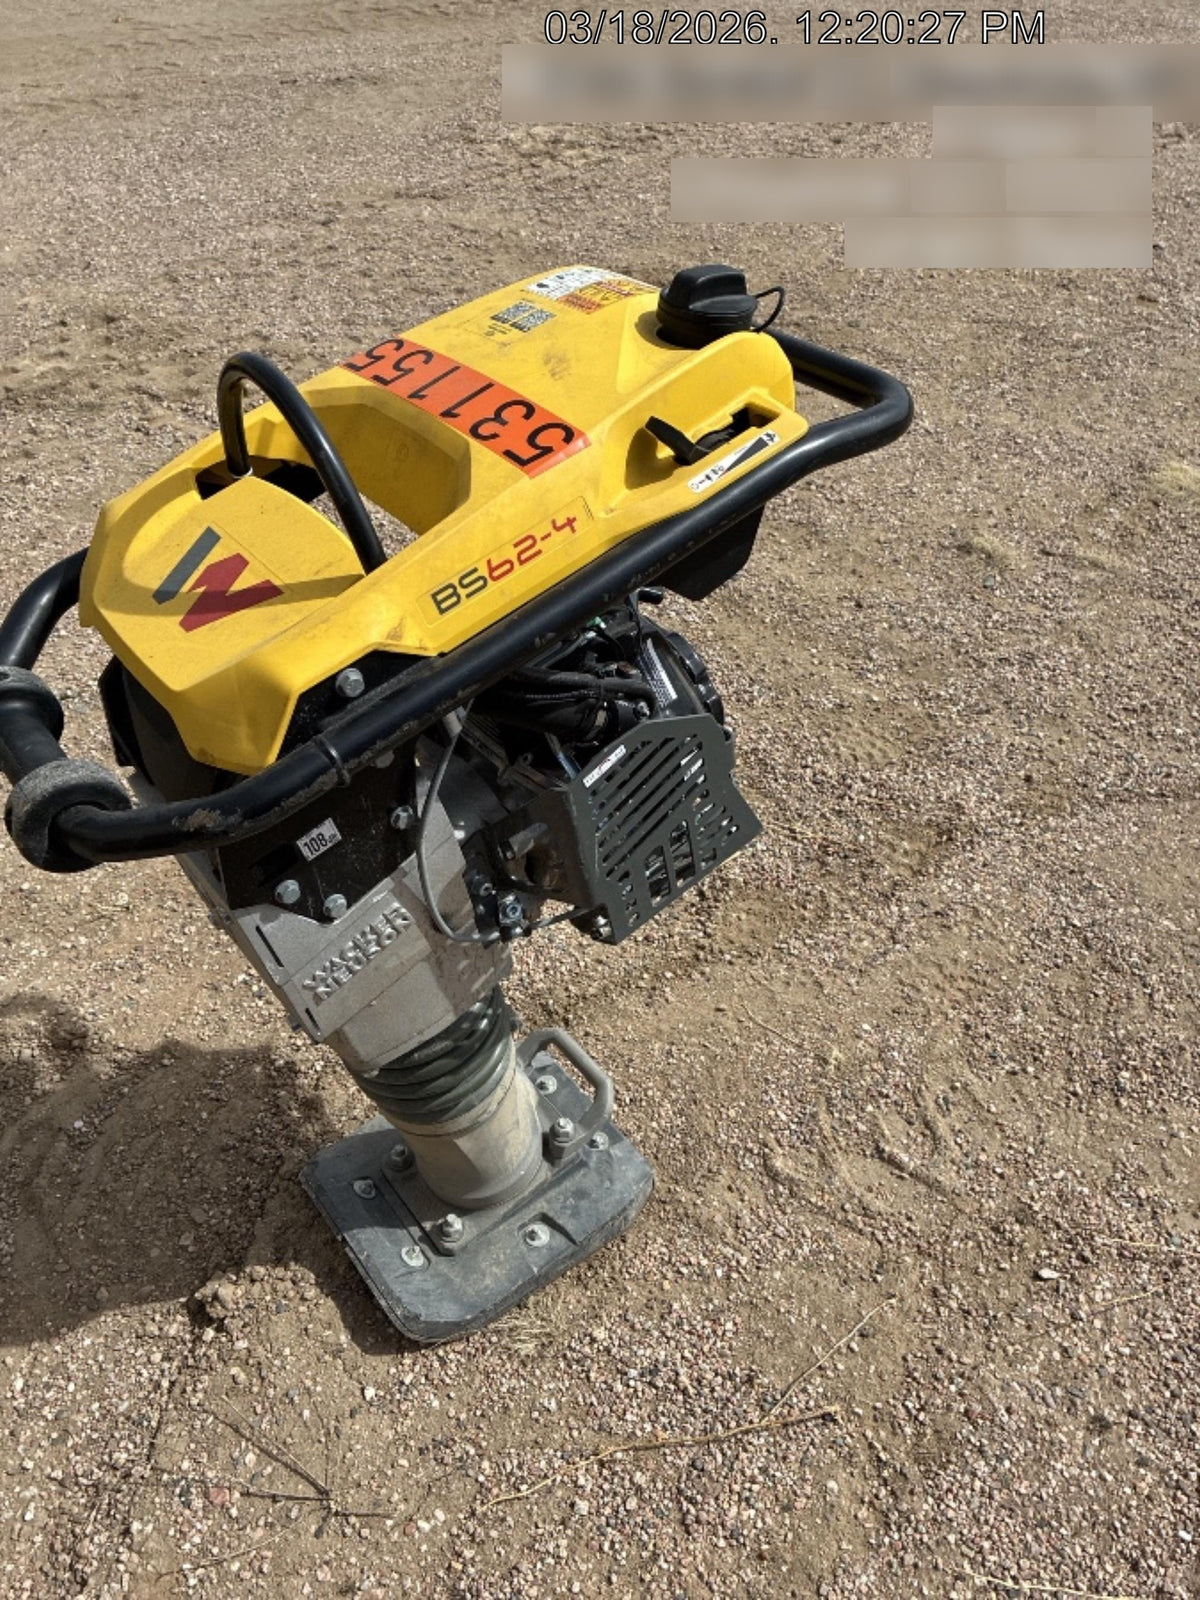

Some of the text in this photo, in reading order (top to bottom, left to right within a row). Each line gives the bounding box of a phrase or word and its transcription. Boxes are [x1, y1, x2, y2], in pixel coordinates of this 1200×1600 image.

[346, 338, 575, 467] 531155
[430, 516, 577, 615] BS62-4
[303, 832, 329, 857] 108
[302, 902, 409, 990] WACKER
